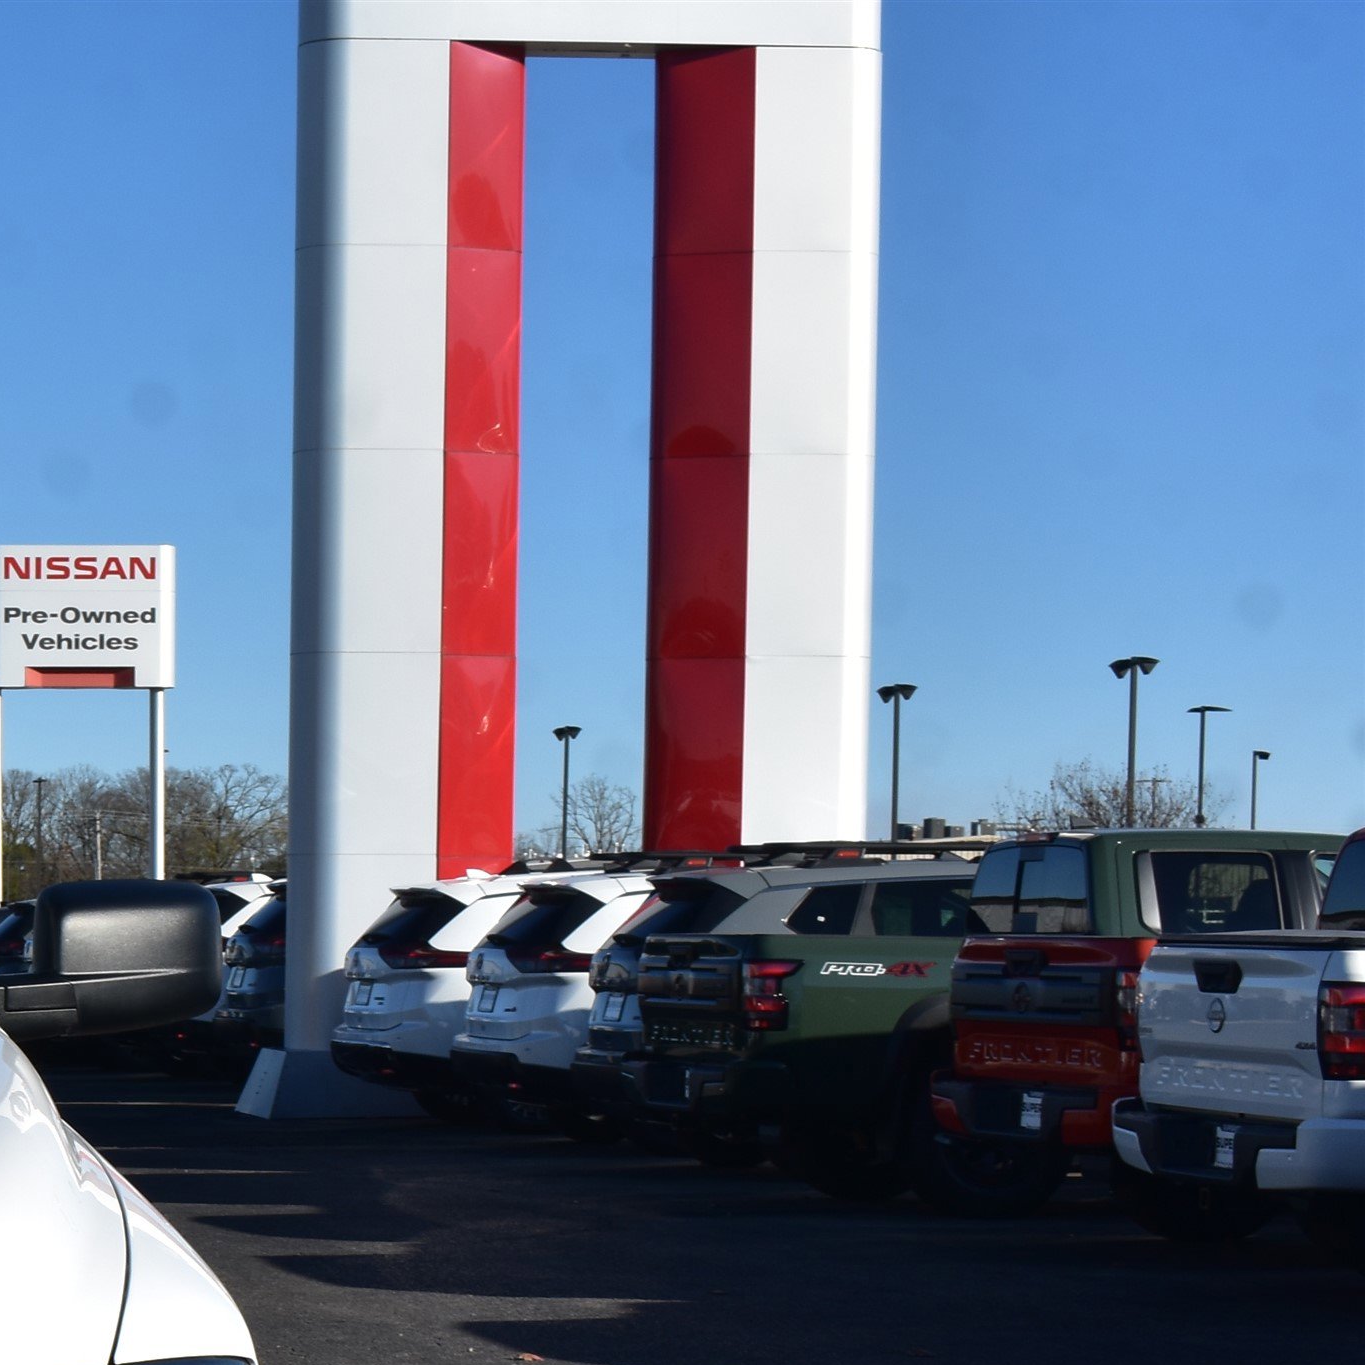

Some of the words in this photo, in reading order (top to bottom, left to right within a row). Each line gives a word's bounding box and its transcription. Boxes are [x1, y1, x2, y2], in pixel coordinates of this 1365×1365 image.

[3, 556, 157, 580] NISSAN
[3, 606, 157, 624] Pre-Owned
[21, 633, 140, 651] Vehicles
[968, 1040, 1103, 1069] FRONTIER
[1155, 1063, 1305, 1099] FRONTIER
